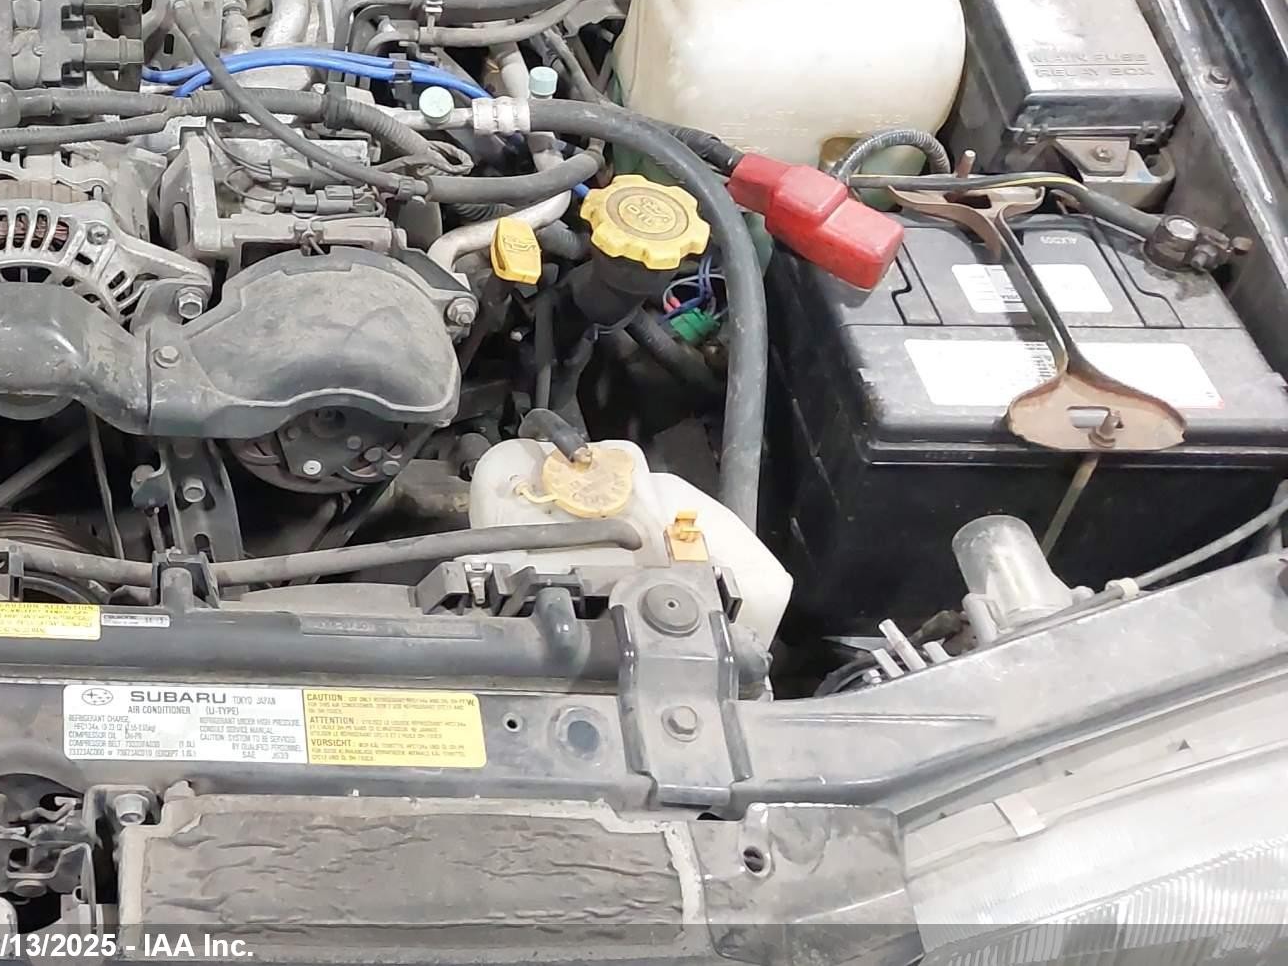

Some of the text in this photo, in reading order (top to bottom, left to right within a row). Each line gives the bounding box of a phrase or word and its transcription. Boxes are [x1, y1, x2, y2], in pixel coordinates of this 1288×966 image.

[1027, 51, 1148, 63] MAIN FUSE
[1034, 67, 1156, 78] RELAY BOX
[626, 204, 654, 226] OIL
[130, 690, 276, 705] SUBARU TOKYO JAPAN
[127, 705, 140, 714] AIR
[142, 705, 191, 715] CONDITIONER
[68, 714, 105, 722] REFRIGERANT
[309, 716, 354, 724] ATTENTION
